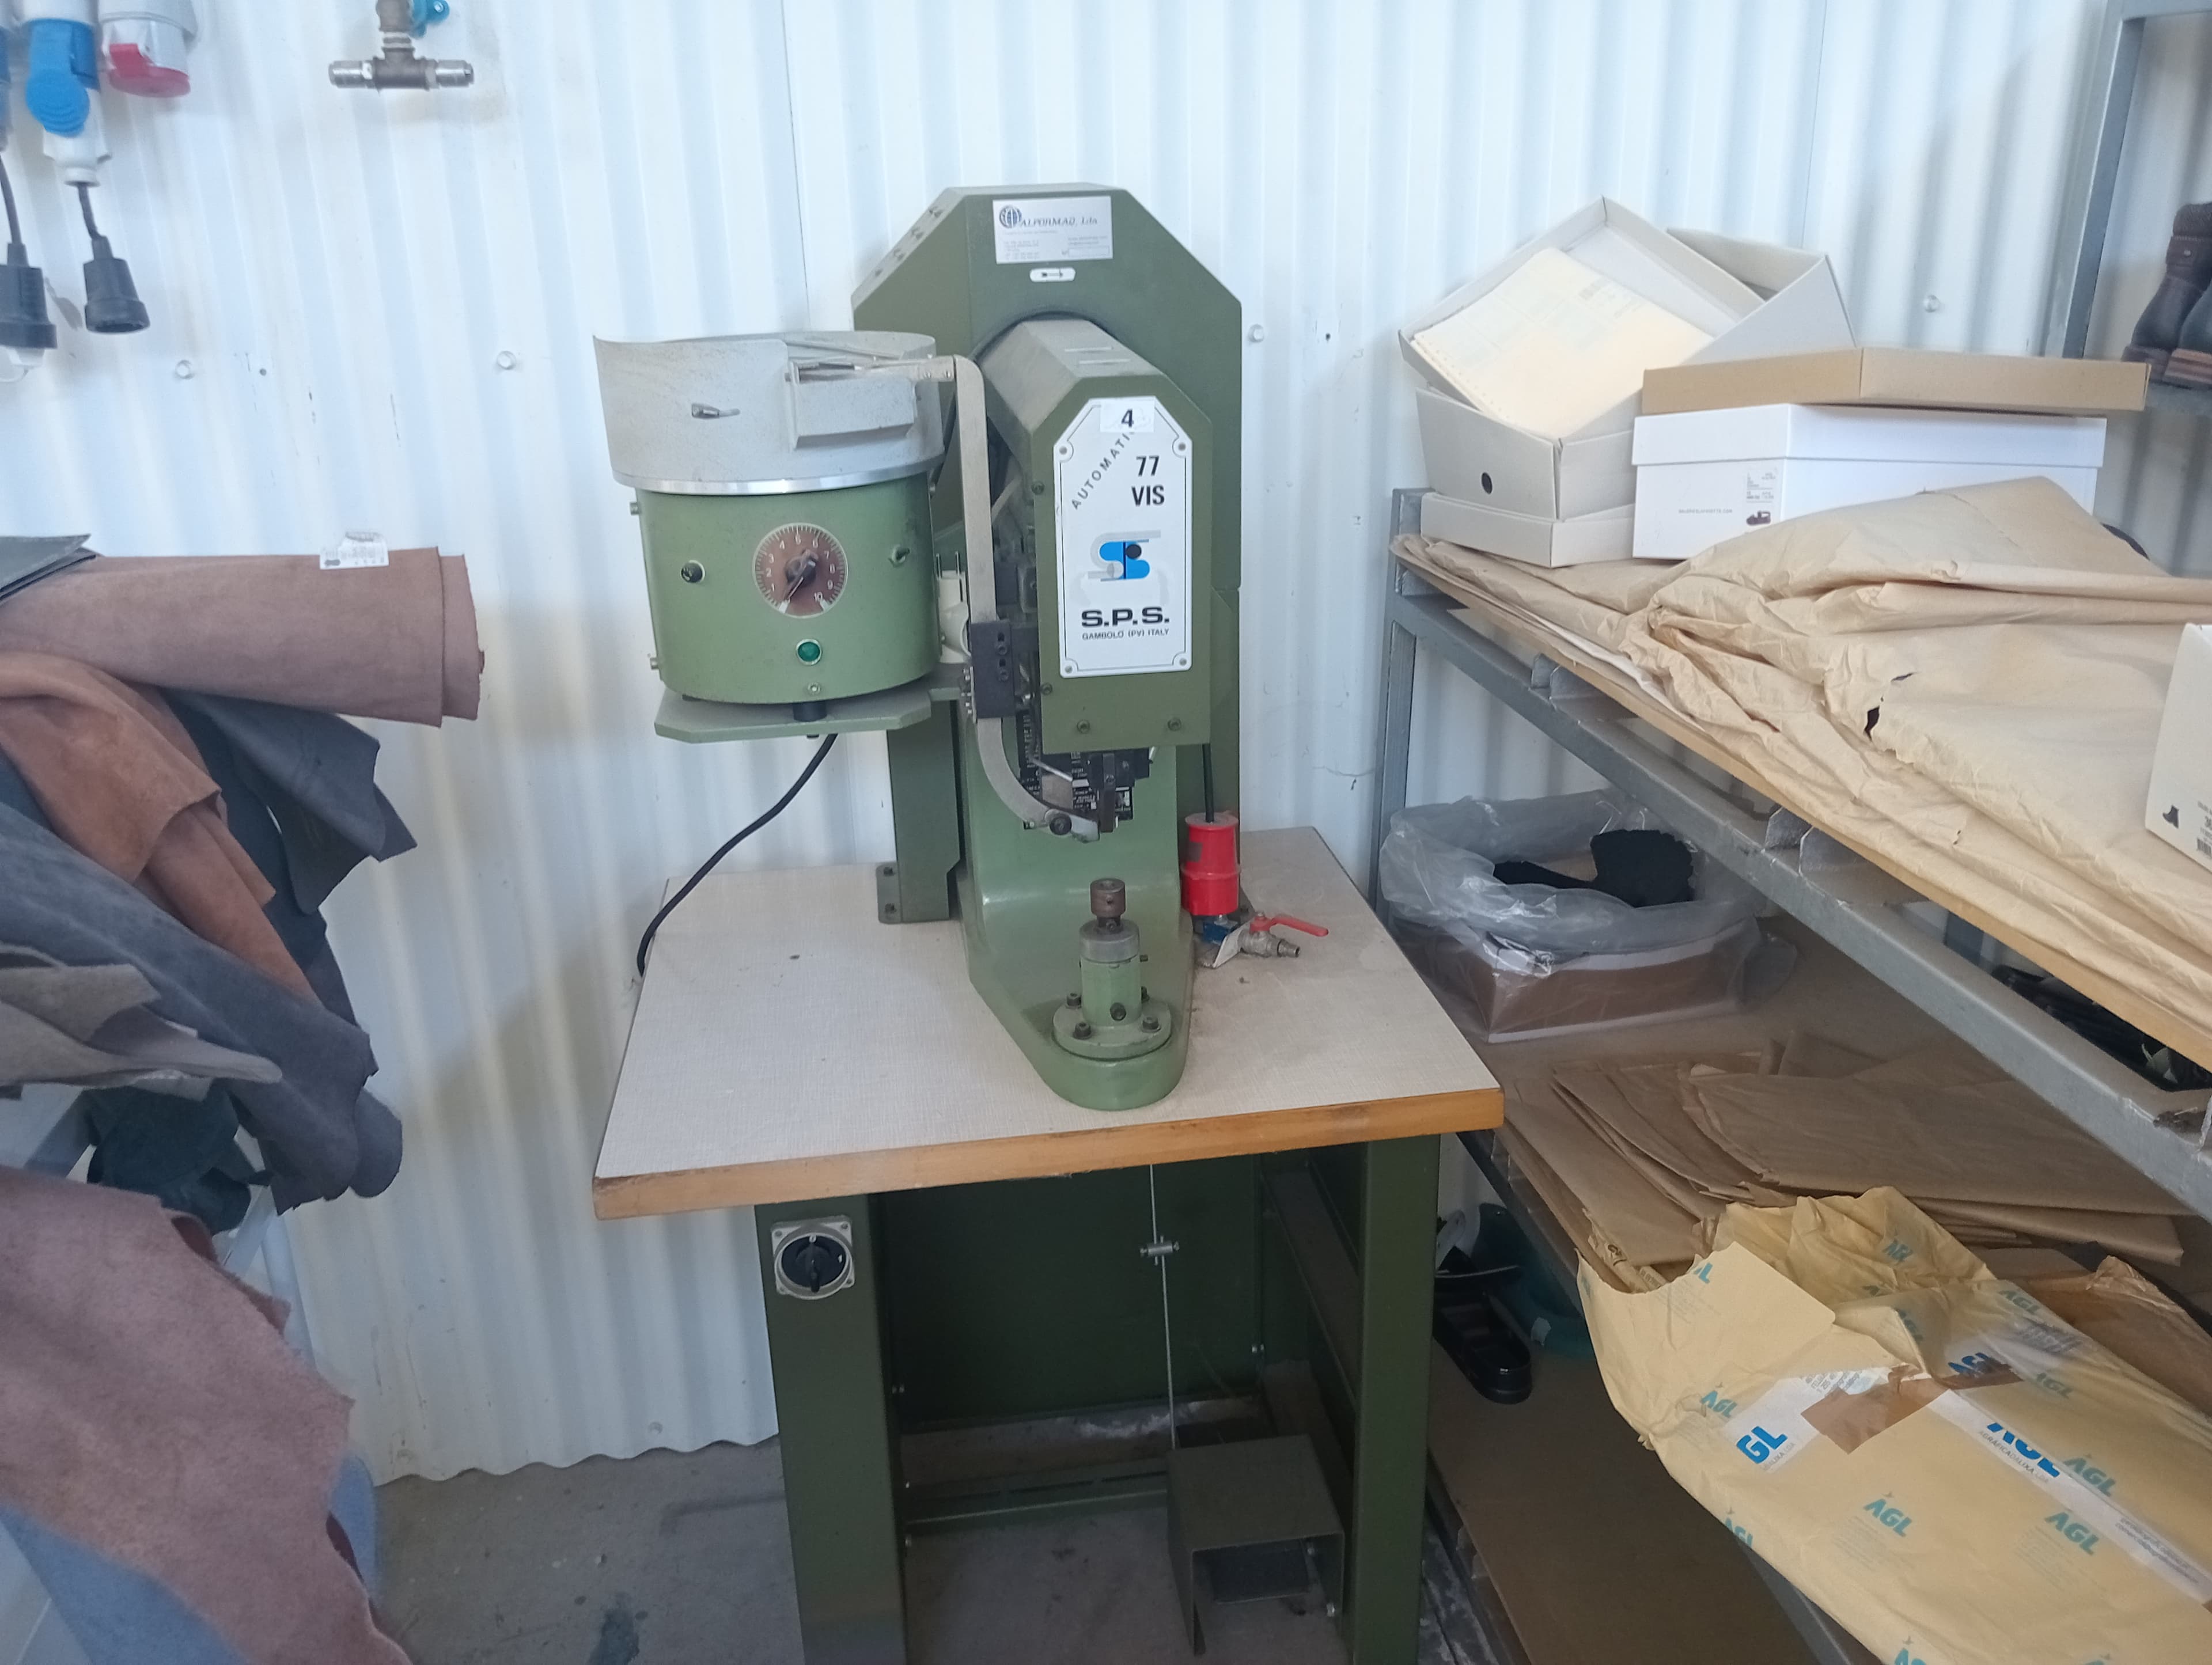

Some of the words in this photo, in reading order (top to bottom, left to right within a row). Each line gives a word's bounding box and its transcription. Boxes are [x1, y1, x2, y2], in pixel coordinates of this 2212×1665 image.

[1122, 408, 1134, 427] 4
[1071, 431, 1134, 510] AUTOMATI
[1136, 455, 1160, 477] 77
[1131, 484, 1165, 507] VIS
[779, 540, 785, 549] 4
[768, 553, 774, 563] 3
[766, 568, 772, 577] 2
[771, 583, 775, 591] 1
[827, 579, 834, 590] 9
[813, 591, 823, 601] 10
[1082, 606, 1169, 627] S.P.S.
[1128, 629, 1145, 638] (PV)
[1148, 628, 1170, 636] ITALY
[1700, 1390, 1738, 1419] AGL
[2063, 1457, 2116, 1497] AGL
[1863, 1499, 1912, 1537] AGL
[2044, 1512, 2099, 1555] AGL
